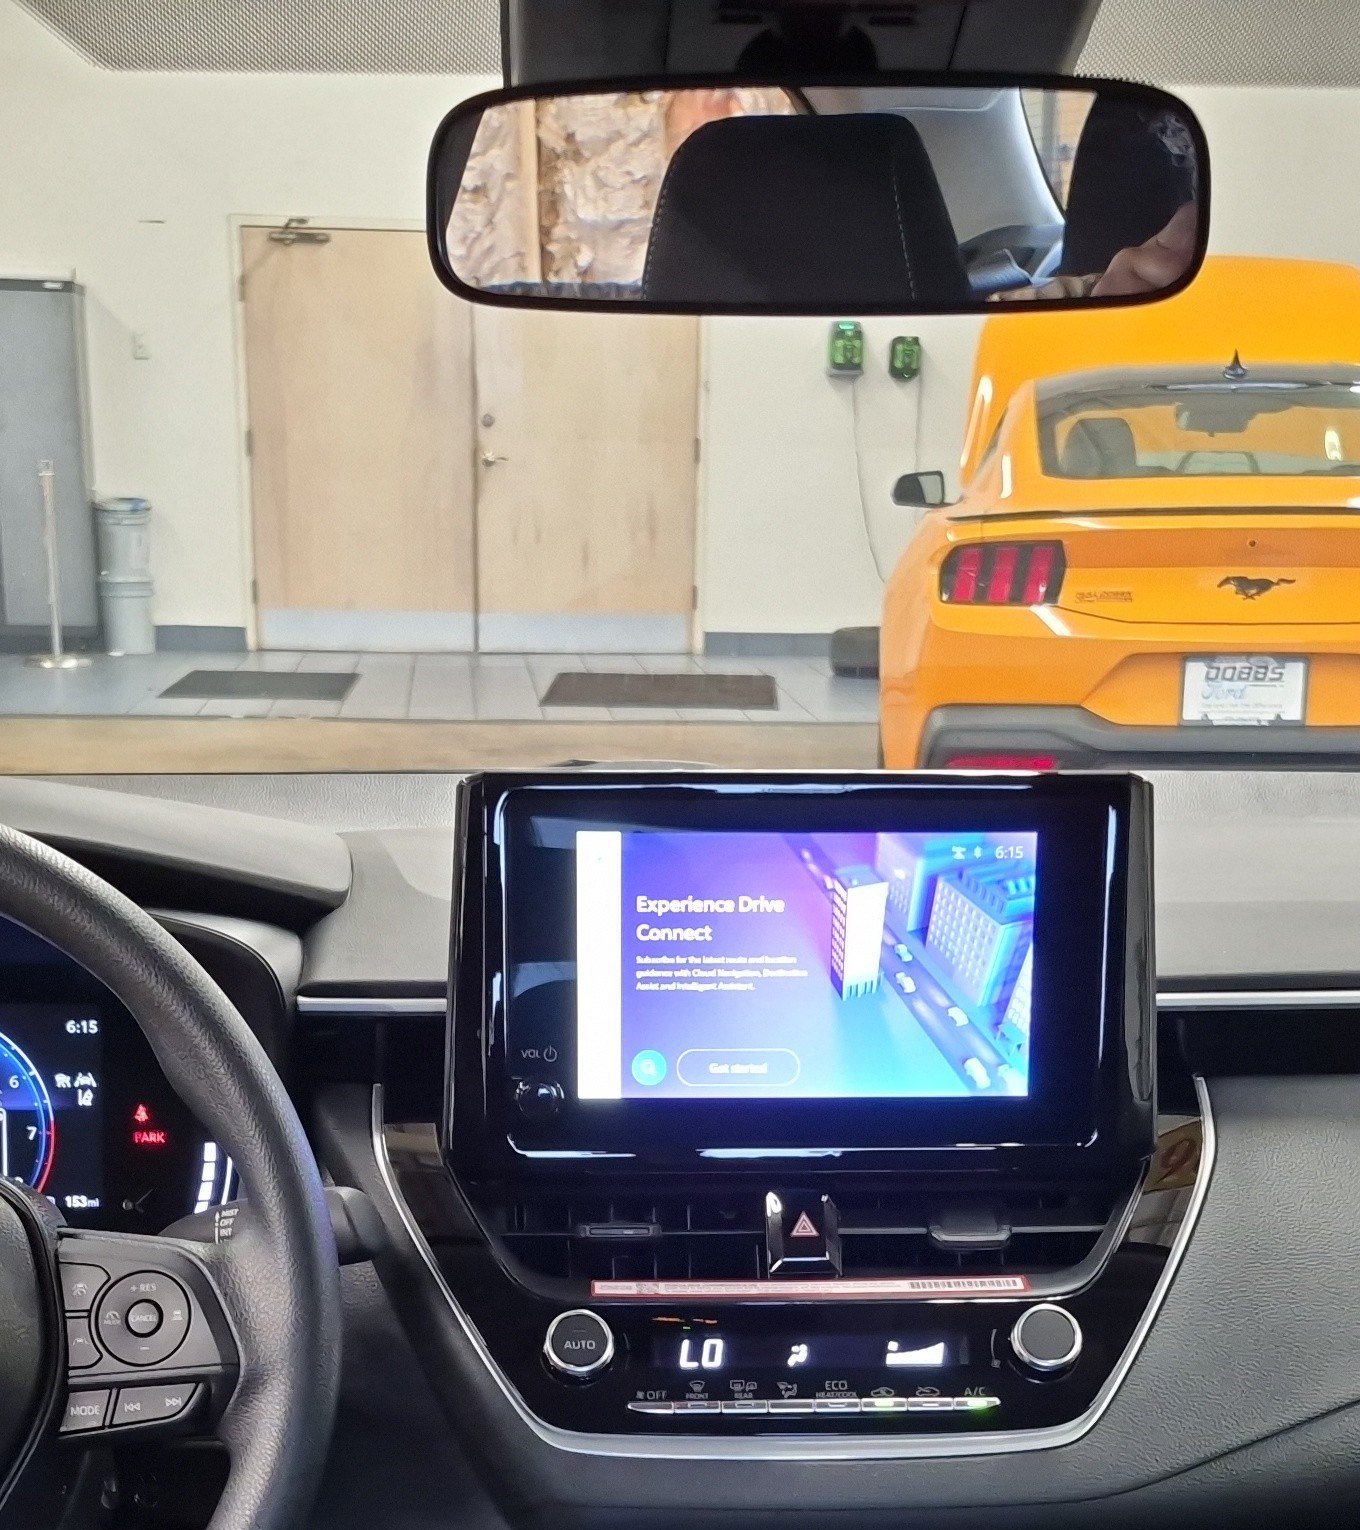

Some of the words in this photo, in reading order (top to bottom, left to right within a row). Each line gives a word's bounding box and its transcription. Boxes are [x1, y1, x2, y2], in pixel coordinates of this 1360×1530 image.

[995, 845, 1024, 859] 6:15
[636, 895, 735, 916] Experience
[738, 895, 785, 913] Drive
[636, 924, 712, 941] Connect
[65, 1019, 99, 1034] 6:15
[8, 1074, 20, 1088] 6
[26, 1125, 38, 1141] 7
[134, 1131, 167, 1144] PARK
[564, 1340, 596, 1350] AUTO
[824, 1380, 848, 1391] ECO
[963, 1386, 987, 1397] A/C
[646, 1390, 667, 1400] OFF
[70, 1404, 101, 1416] MODE
